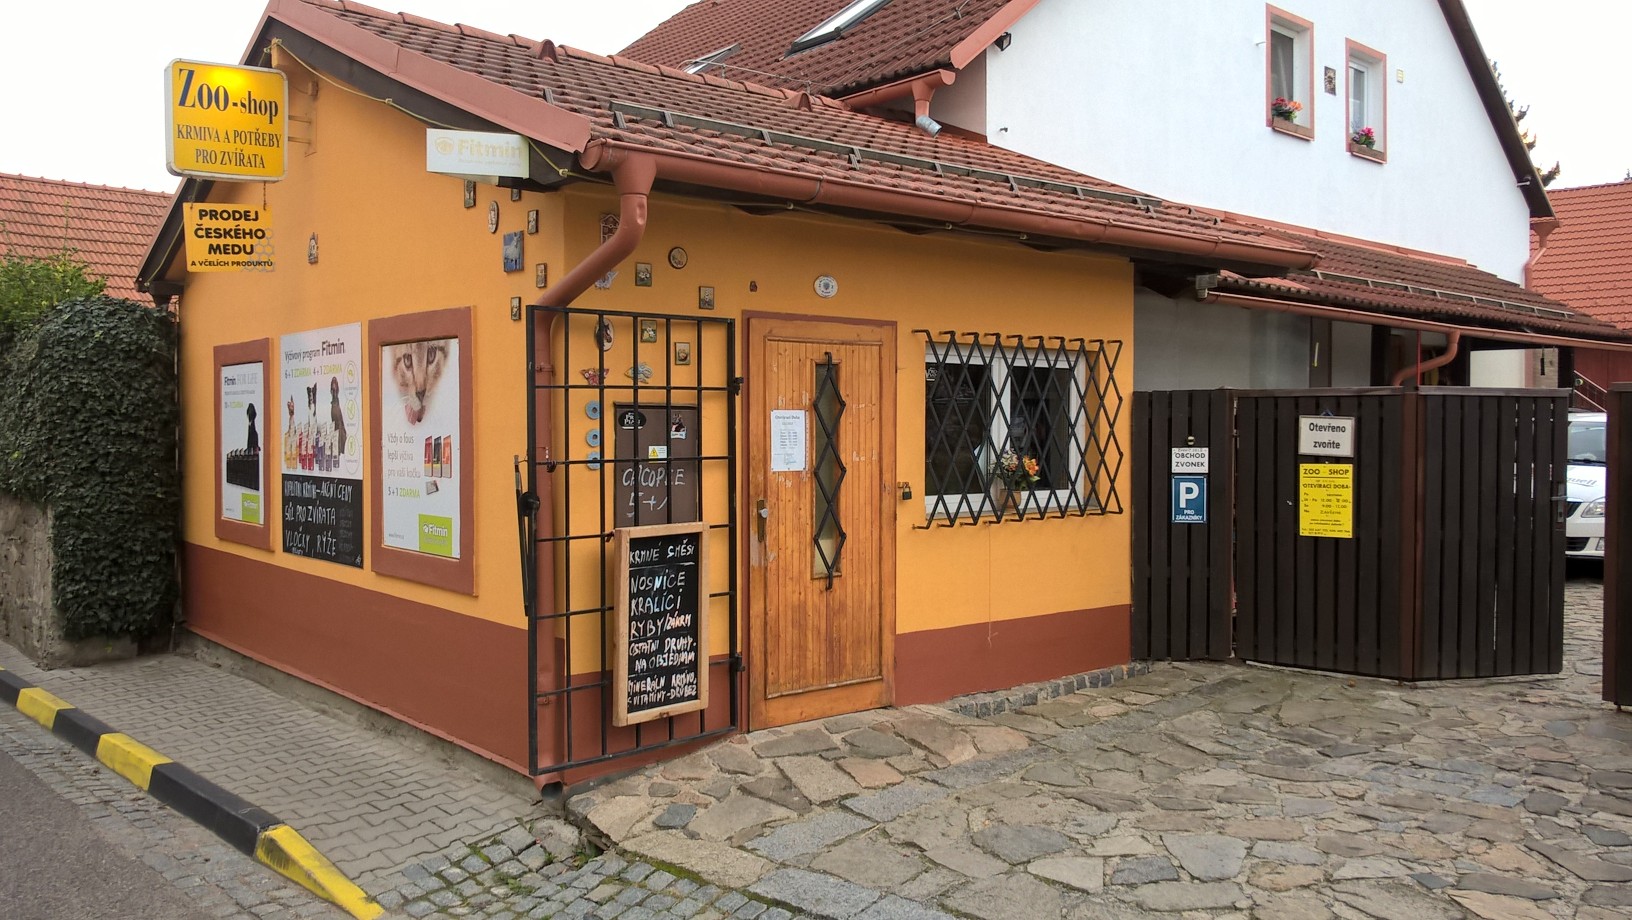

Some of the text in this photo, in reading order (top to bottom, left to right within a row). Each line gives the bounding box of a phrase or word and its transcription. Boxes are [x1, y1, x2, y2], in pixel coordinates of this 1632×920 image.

[177, 124, 281, 148] KRMIVA A POTŘEBY
[195, 148, 265, 169] PRO ZVÍŘATA
[198, 209, 259, 221] PRODEJ
[194, 224, 266, 240] ČESKÉHO
[208, 243, 254, 255] MEDU
[198, 259, 230, 267] VČELÍCH
[232, 258, 272, 267] PRODUKTŮ
[322, 338, 345, 356] Fitmin
[1309, 422, 1346, 433] Otevřeno
[1313, 440, 1341, 449] zvoňte
[1180, 482, 1199, 508] P
[429, 524, 448, 536] Fitmin
